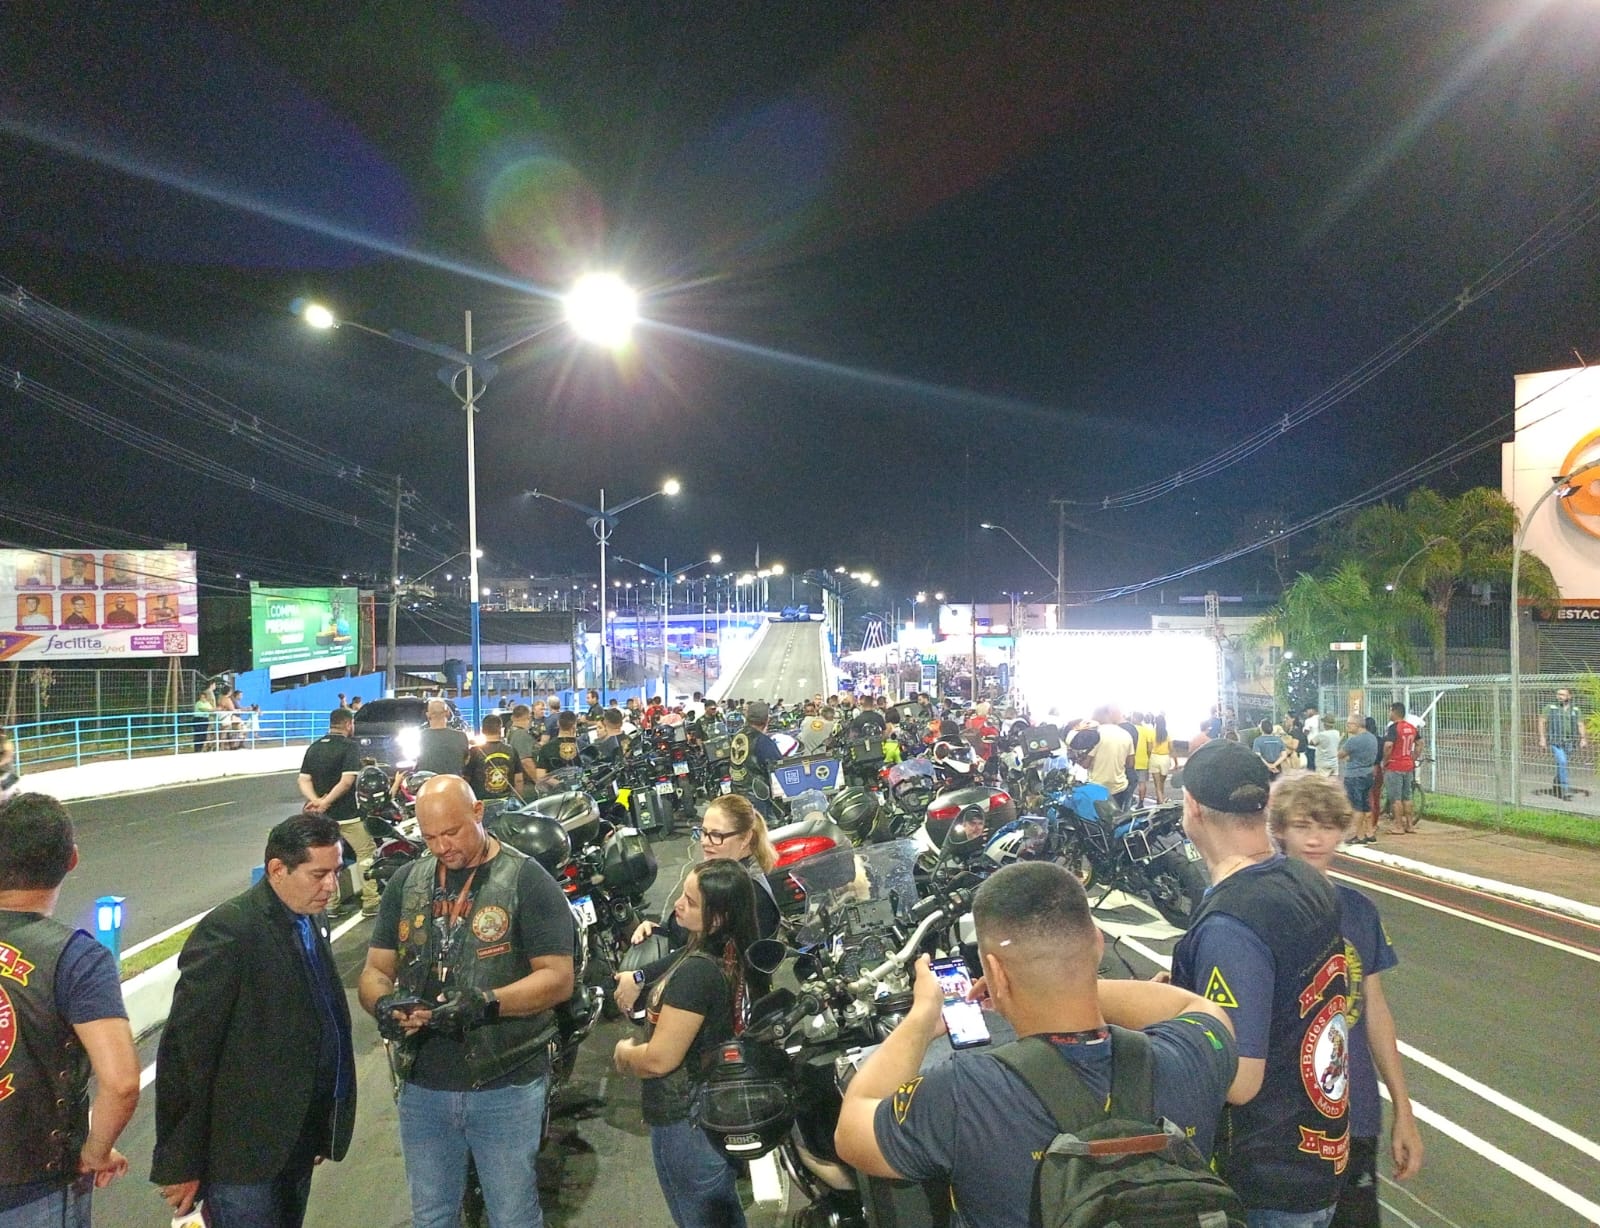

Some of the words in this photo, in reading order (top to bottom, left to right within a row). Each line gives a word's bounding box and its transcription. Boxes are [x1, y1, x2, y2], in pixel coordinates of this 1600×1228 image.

[41, 634, 102, 653] facilita
[1303, 1016, 1326, 1065] Bodes
[1317, 1097, 1340, 1116] Moto
[1322, 1145, 1336, 1156] RIO
